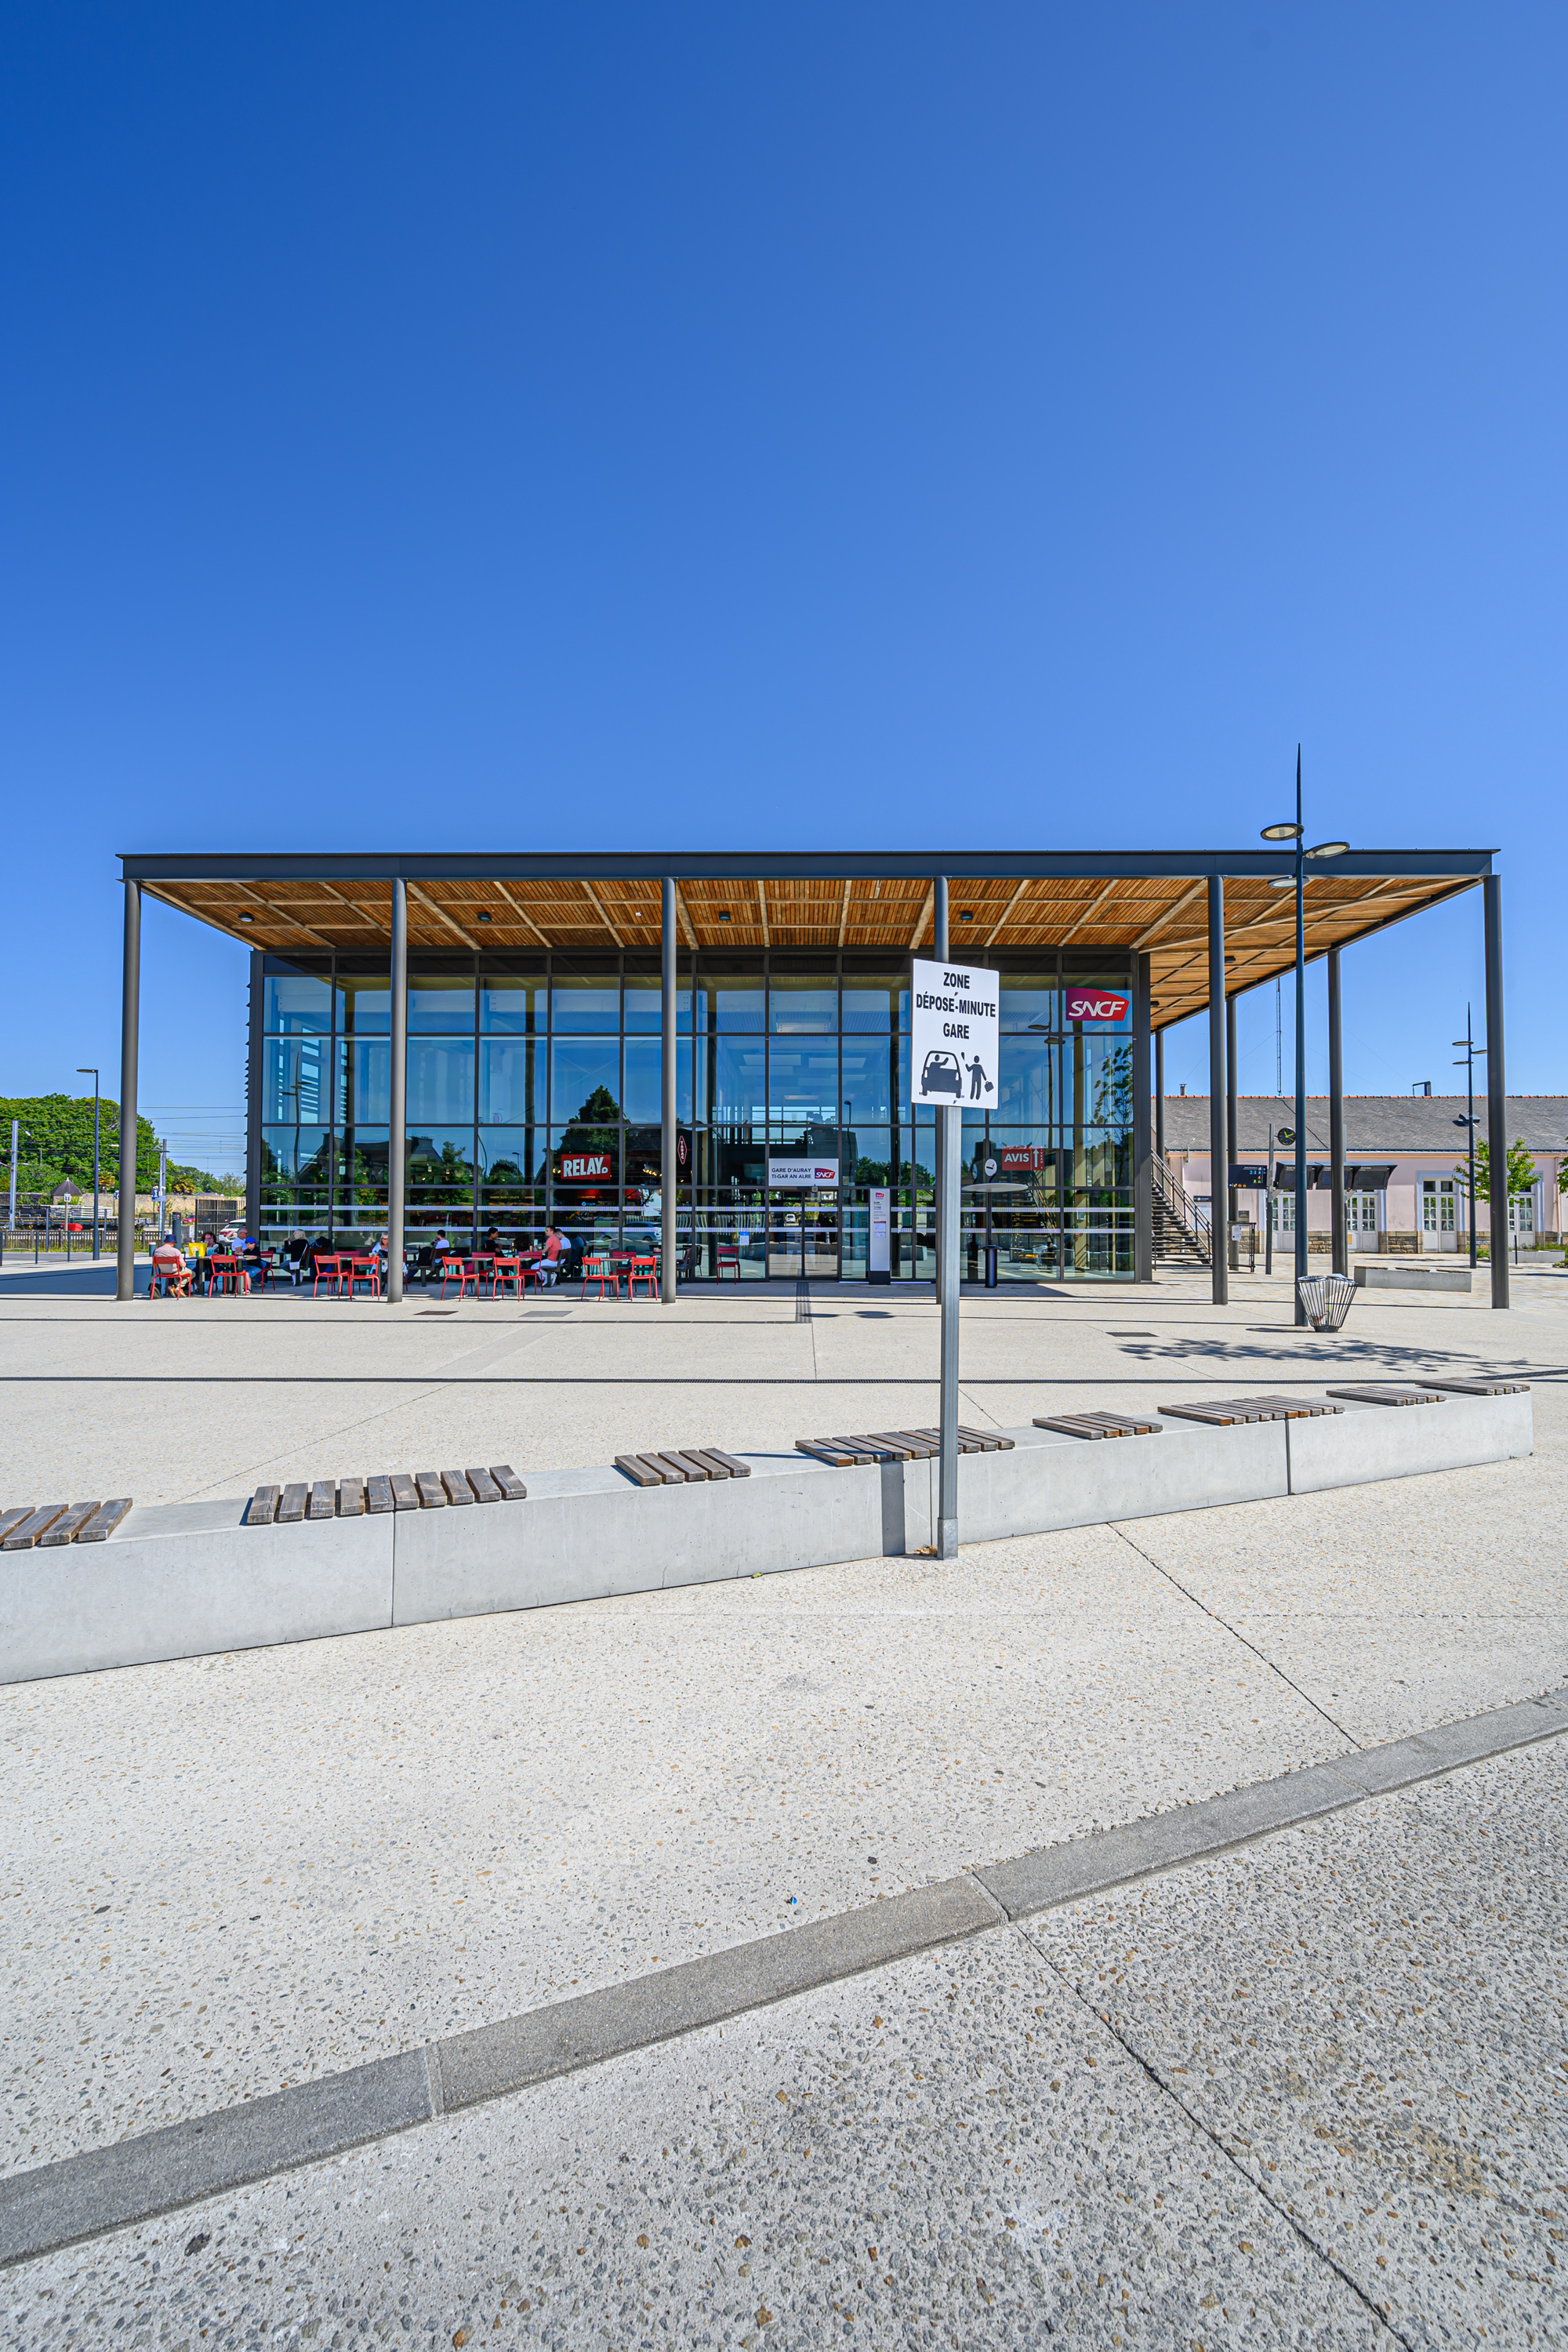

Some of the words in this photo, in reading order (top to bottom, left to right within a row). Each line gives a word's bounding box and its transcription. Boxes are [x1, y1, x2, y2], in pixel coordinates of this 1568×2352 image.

[943, 972, 970, 989] ZONE
[1069, 1001, 1125, 1017] SNCF
[943, 1023, 970, 1040] GARE
[1004, 1153, 1029, 1163] AVIS
[563, 1157, 604, 1177] RELAY
